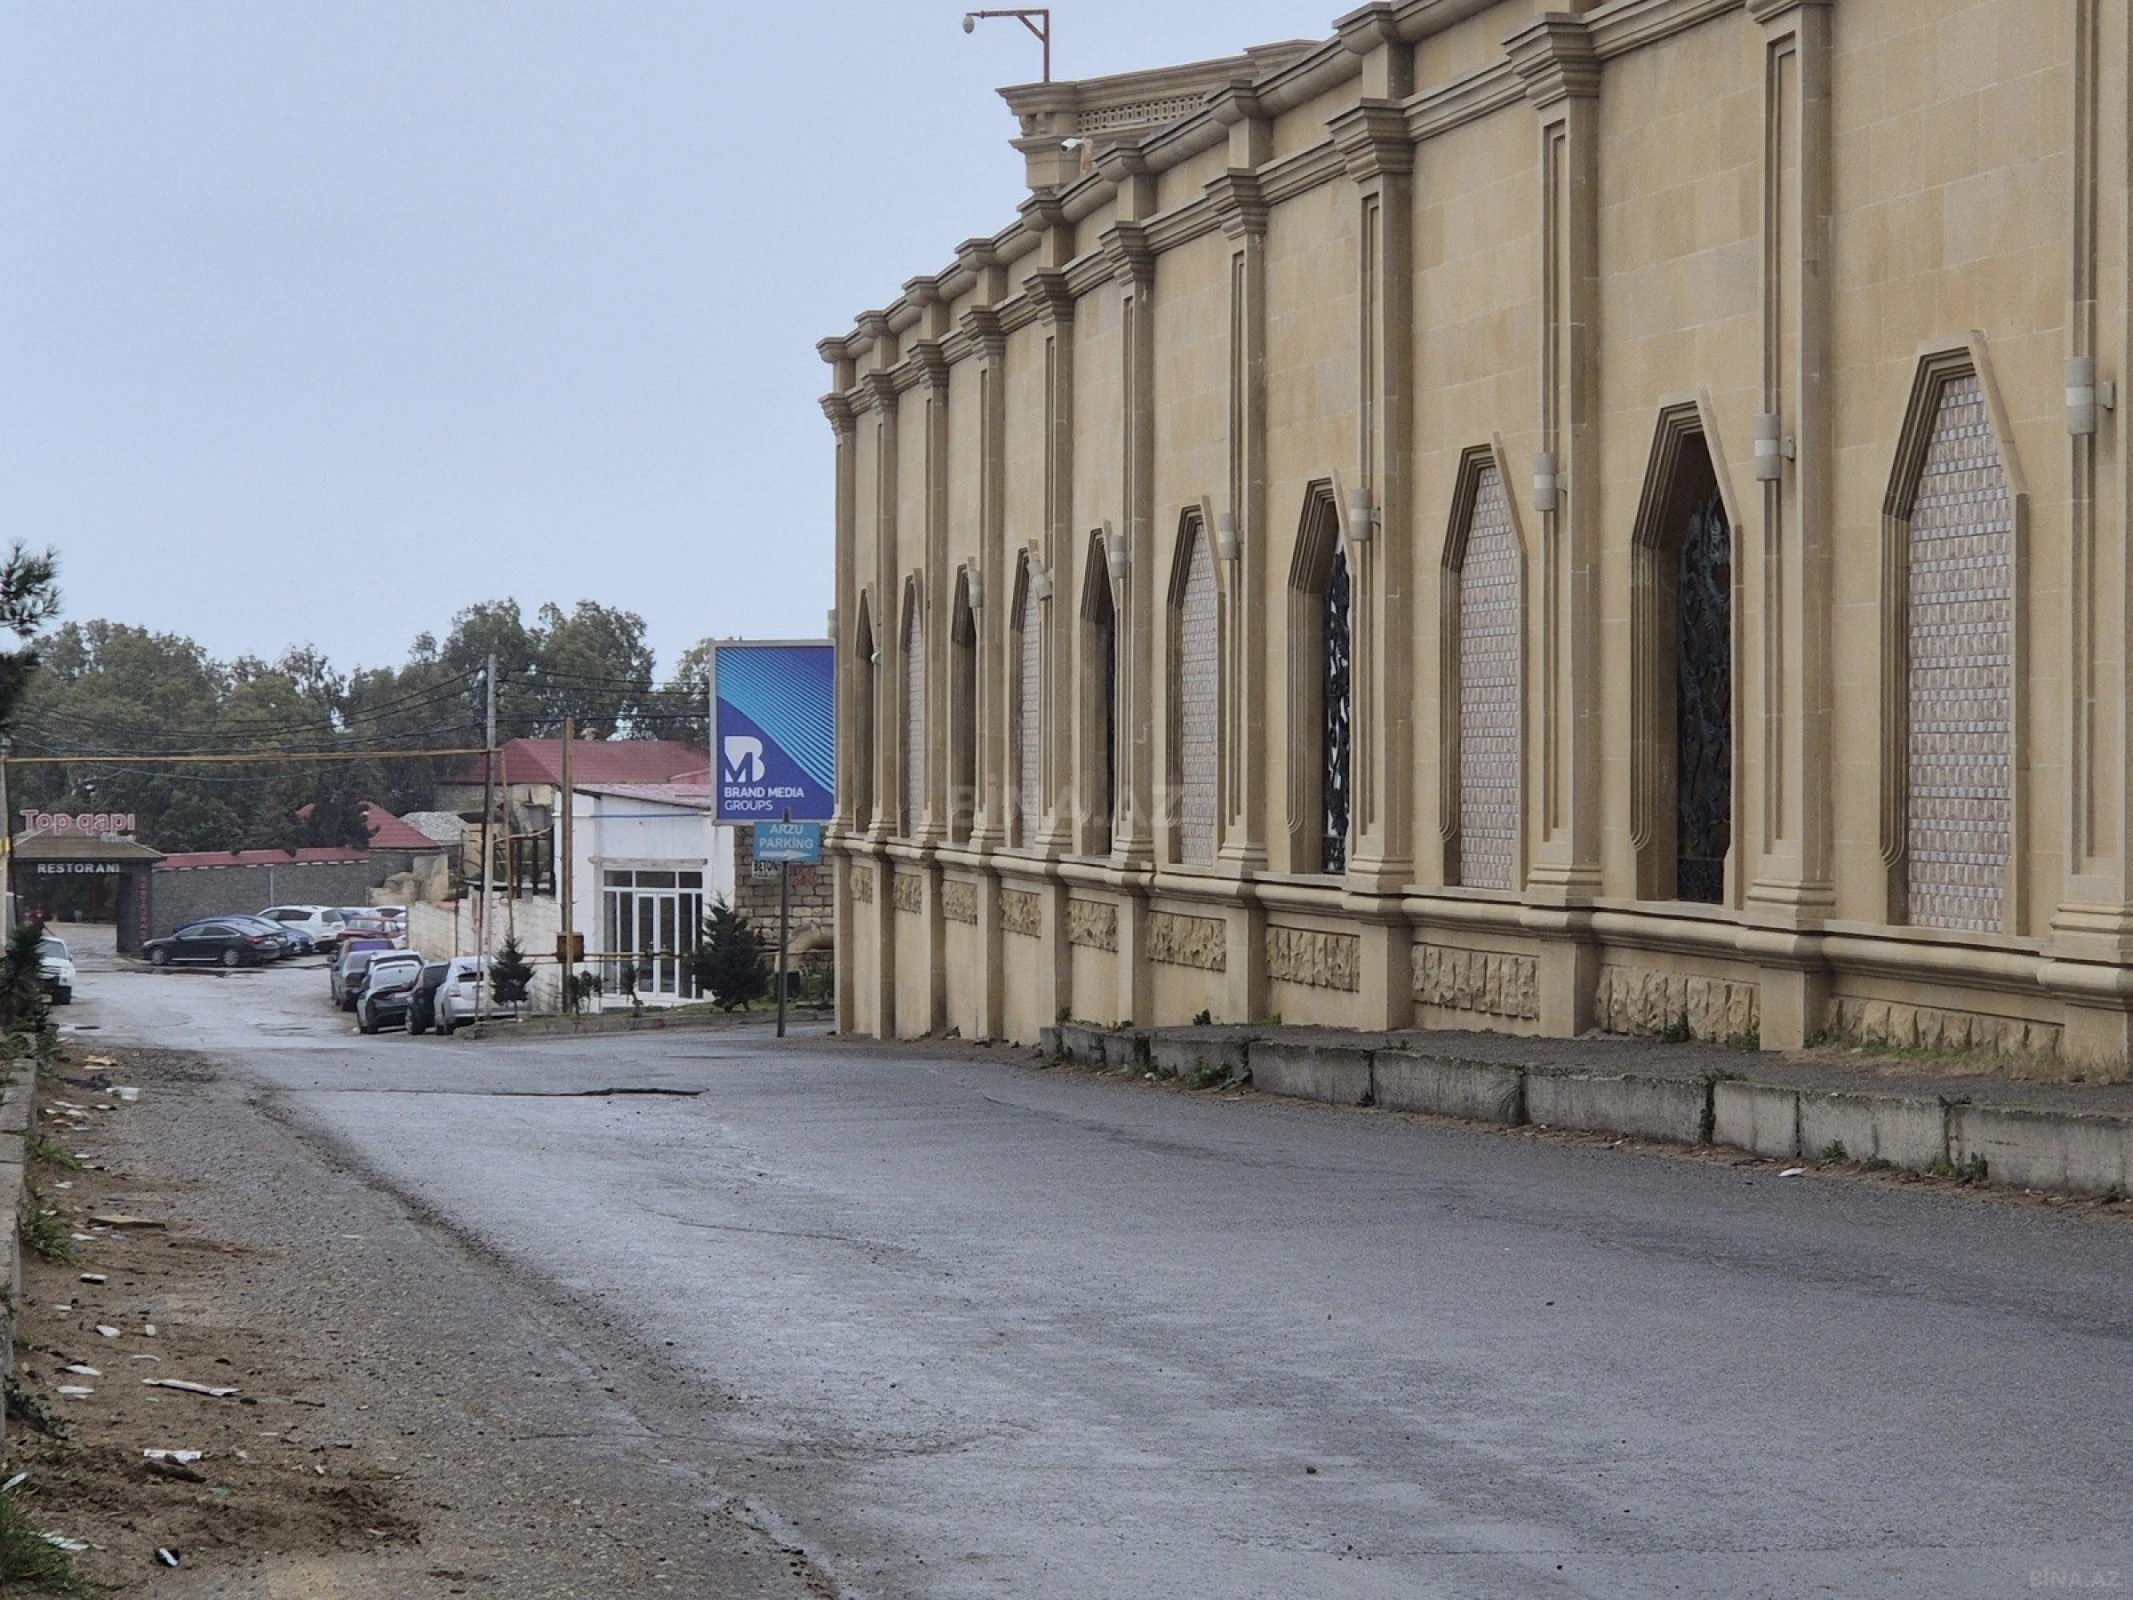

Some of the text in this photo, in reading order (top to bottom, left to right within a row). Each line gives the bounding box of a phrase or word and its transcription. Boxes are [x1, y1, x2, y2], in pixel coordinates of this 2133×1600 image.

[724, 787, 804, 798] BRAND MEDIA
[724, 800, 774, 811] GROUPS
[20, 809, 72, 835] Top
[769, 823, 803, 834] ARZU
[37, 863, 120, 873] RESTORANI
